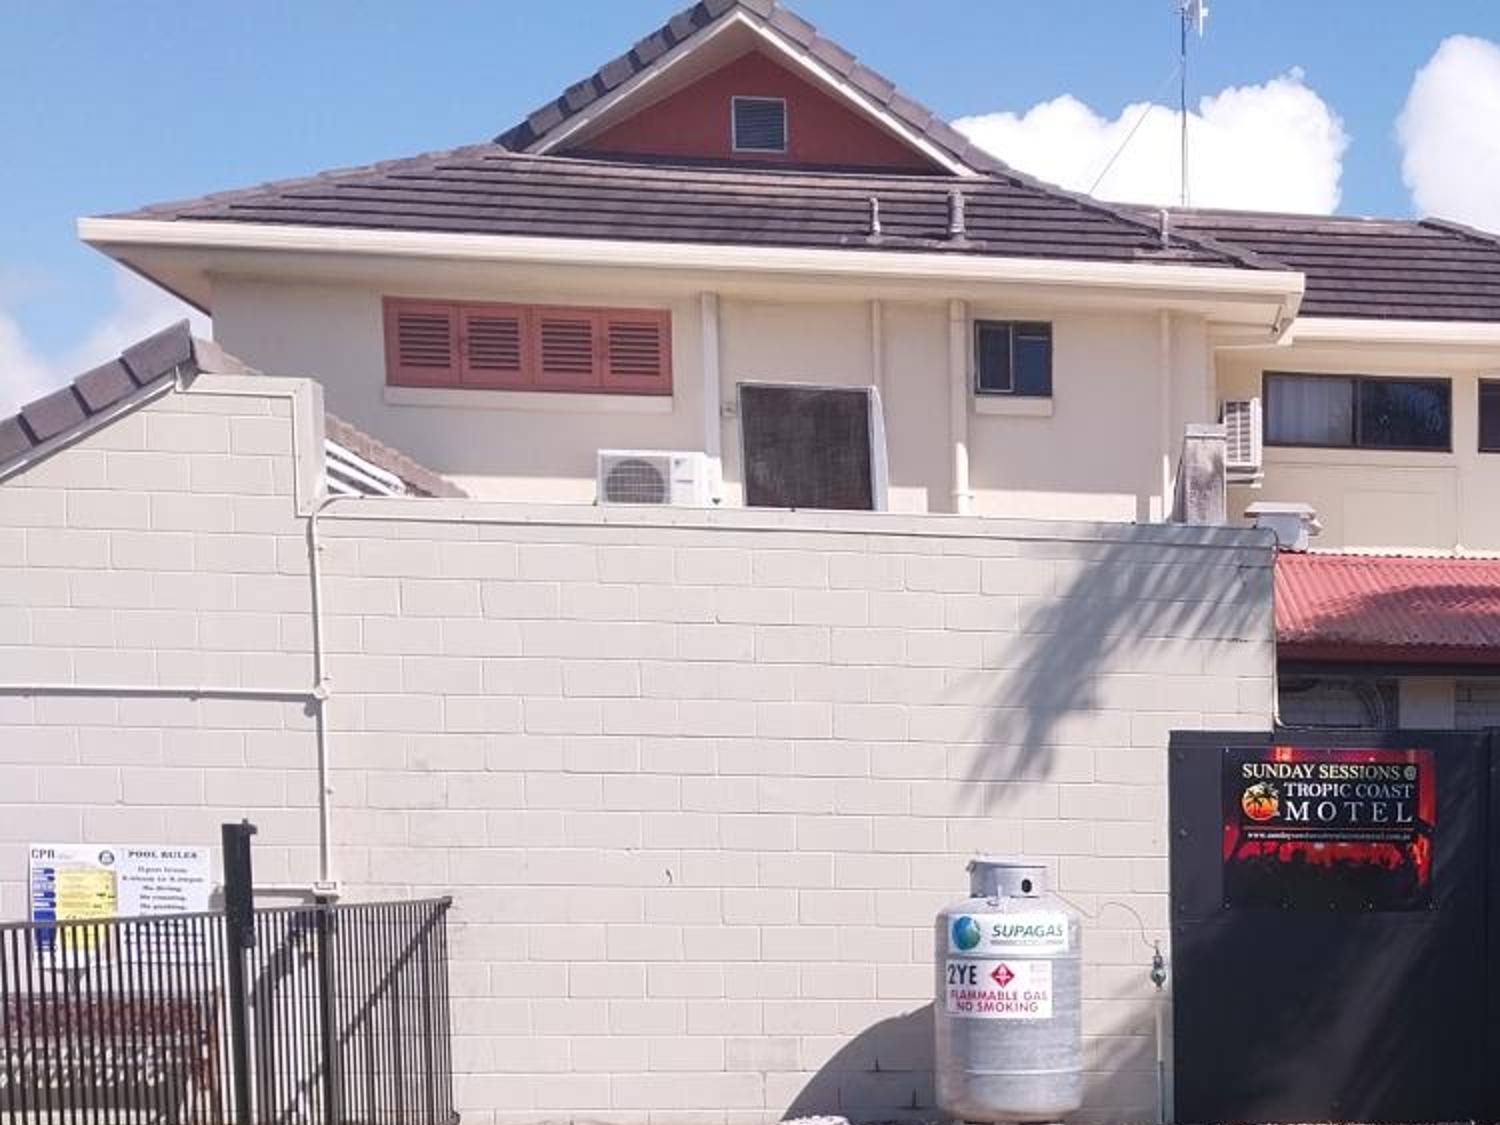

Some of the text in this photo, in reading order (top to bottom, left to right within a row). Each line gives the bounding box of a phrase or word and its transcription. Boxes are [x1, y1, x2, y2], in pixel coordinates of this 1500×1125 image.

[1242, 763, 1315, 779] SUNDAY
[1319, 764, 1400, 779] SESSIONS
[1284, 782, 1414, 798] TROPIC COAST
[1285, 801, 1413, 822] MOTEL
[128, 851, 197, 859] POOL RULES
[991, 923, 1064, 937] SUPAGAS
[947, 964, 977, 985] 2YE
[950, 990, 1048, 1001] FLAMMABLE GAS
[957, 1001, 1039, 1012] NO SMOKING
